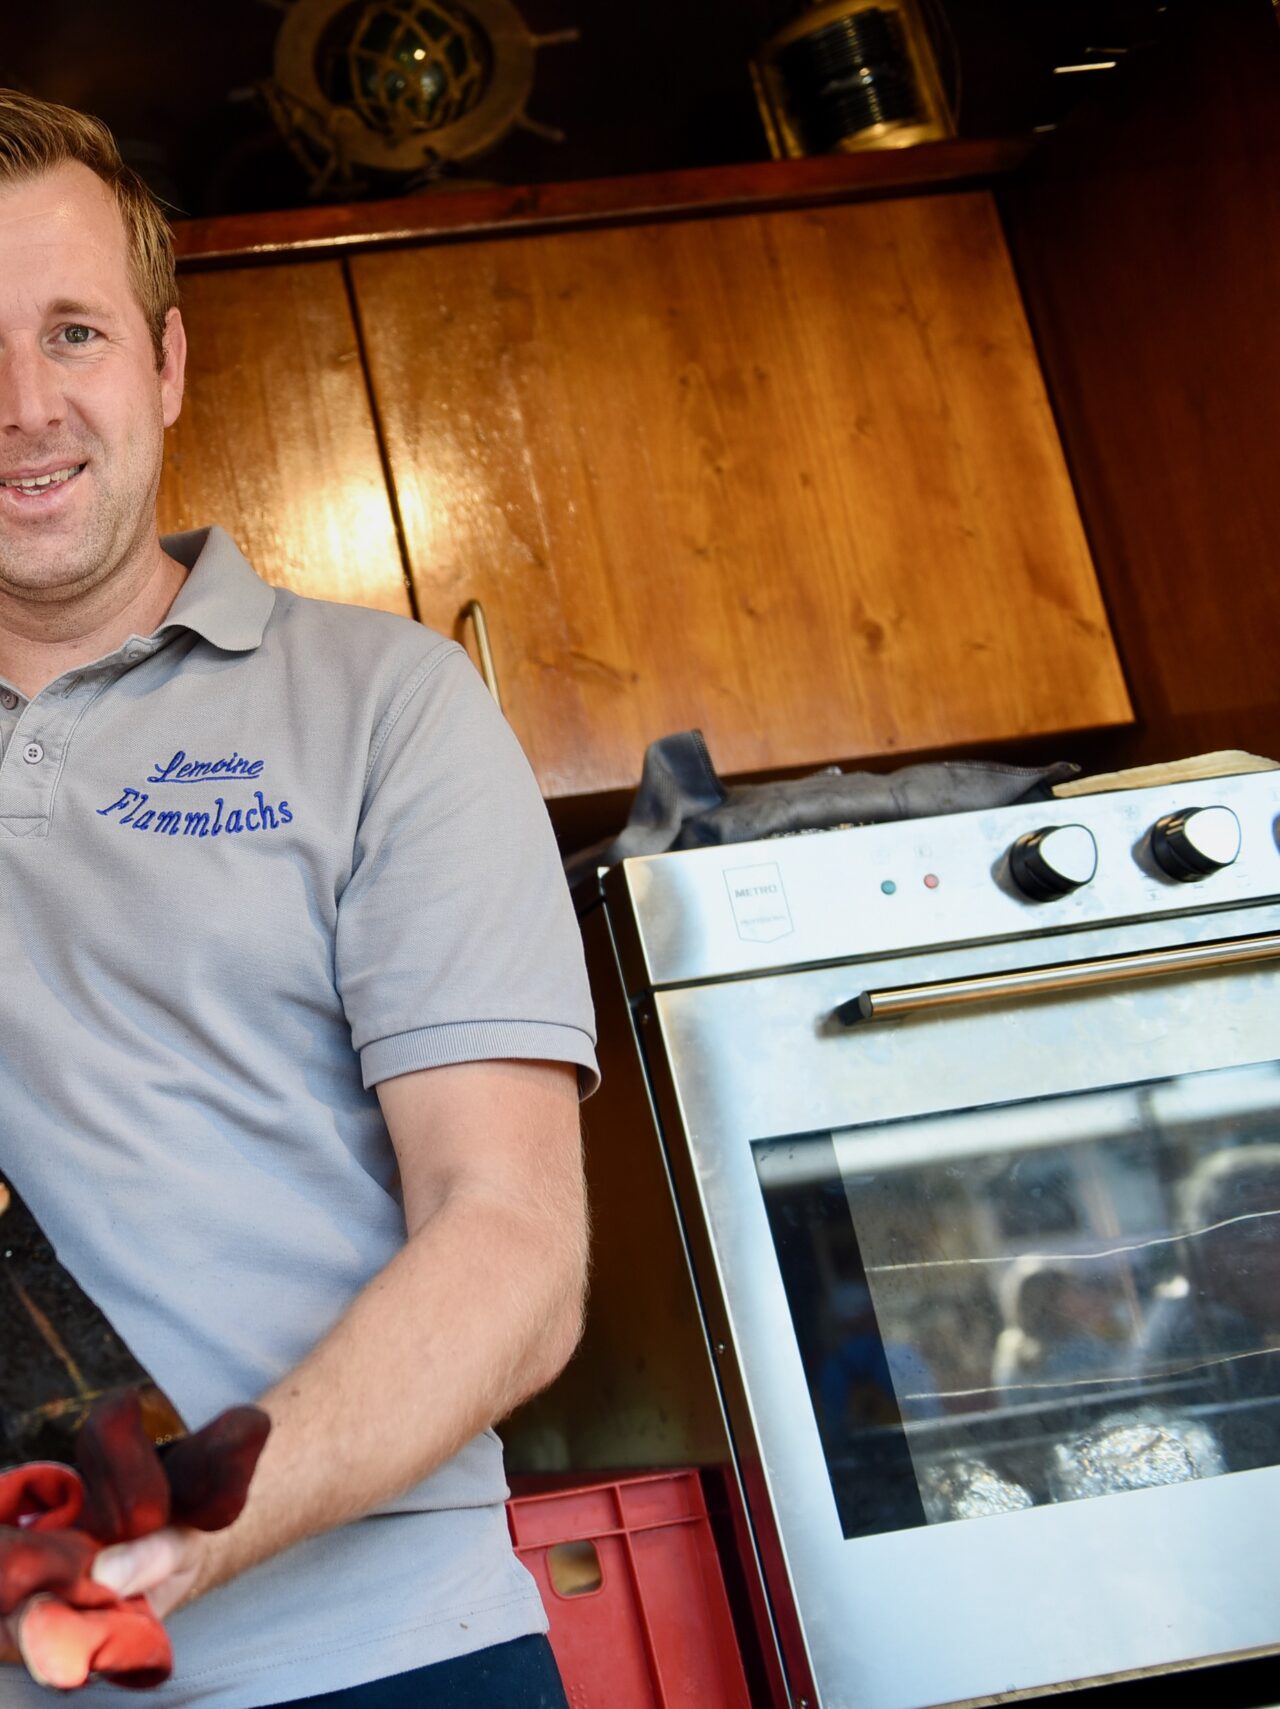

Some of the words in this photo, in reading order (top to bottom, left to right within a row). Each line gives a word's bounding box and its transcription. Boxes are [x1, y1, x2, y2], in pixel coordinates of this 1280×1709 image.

[147, 751, 264, 783] Lemoine
[96, 788, 293, 838] Flammlachs
[734, 884, 778, 898] METRO
